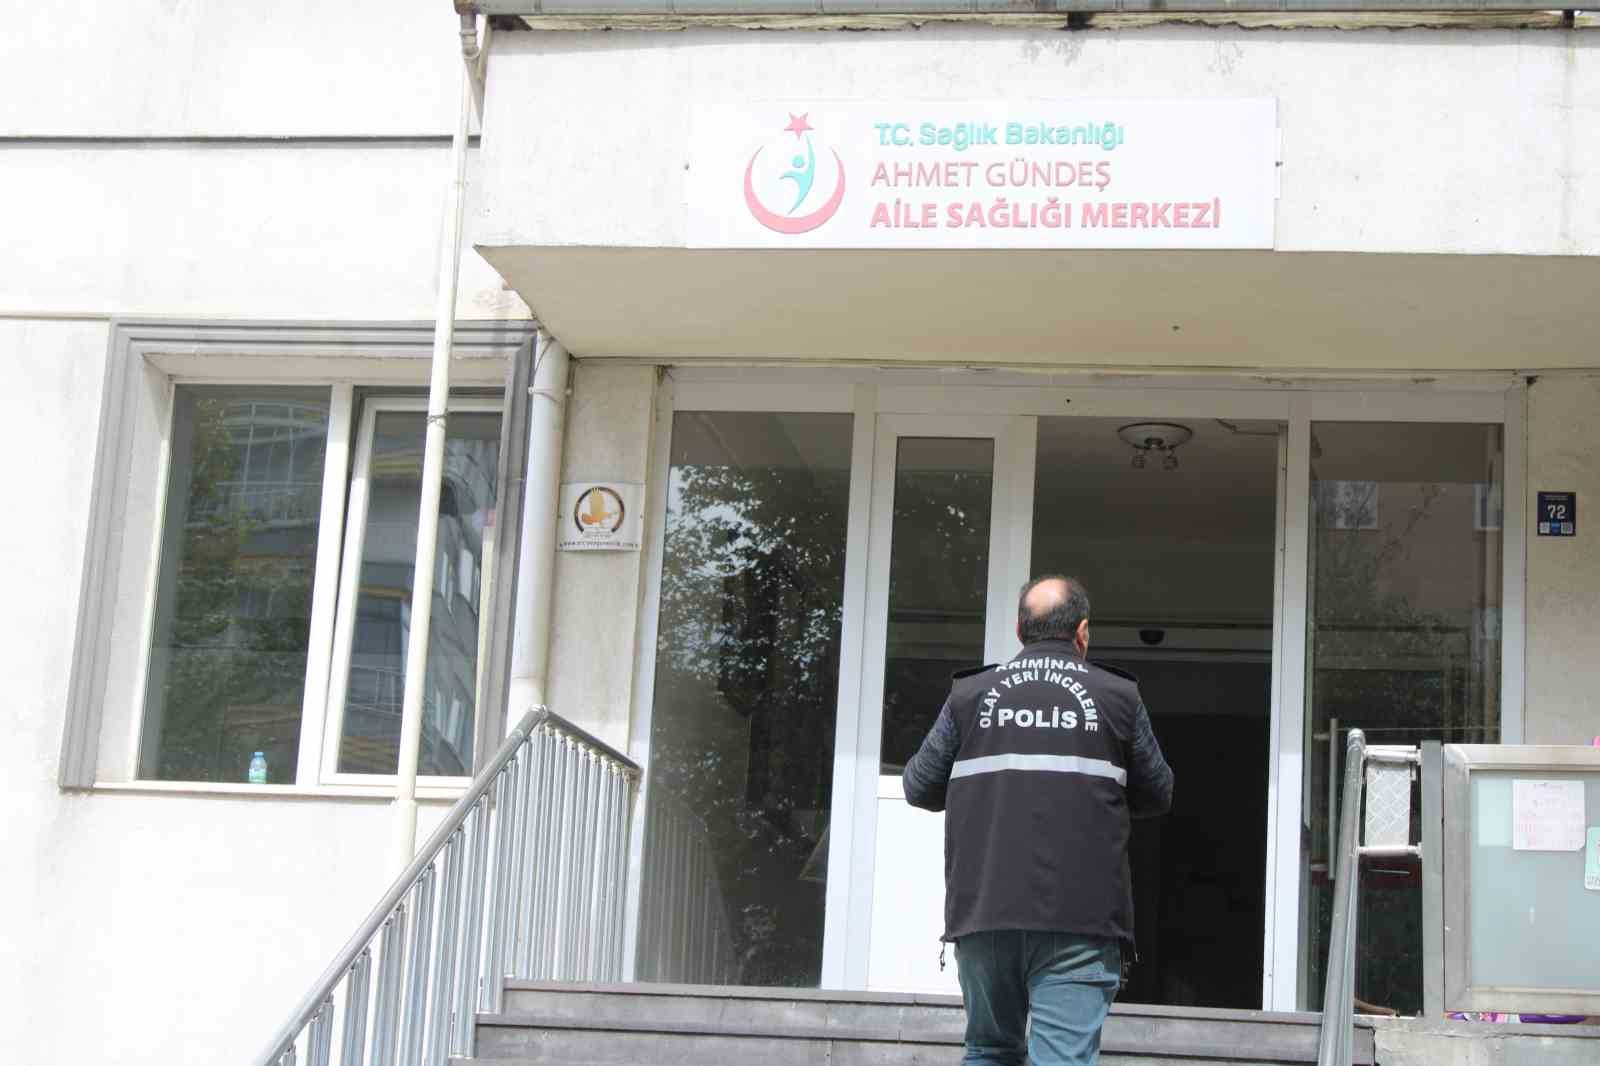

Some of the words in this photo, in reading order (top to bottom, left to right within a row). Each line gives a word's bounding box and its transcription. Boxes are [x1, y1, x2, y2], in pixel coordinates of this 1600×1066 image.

[874, 122, 914, 147] T.C.
[919, 121, 998, 151] Sağlık
[1005, 121, 1125, 151] Bakanlığı
[871, 161, 979, 188] AHMET
[985, 157, 1112, 192] GÜNDEŞ
[870, 198, 938, 228] AİLE
[945, 197, 1072, 228] SAĞLIĞI
[1081, 197, 1221, 228] MERKEZİ
[1547, 504, 1566, 520] 72
[979, 687, 1001, 729] OLAY
[1000, 668, 1039, 689] YERİ
[1044, 669, 1099, 732] İNCELEME
[998, 706, 1078, 729] POLİS
